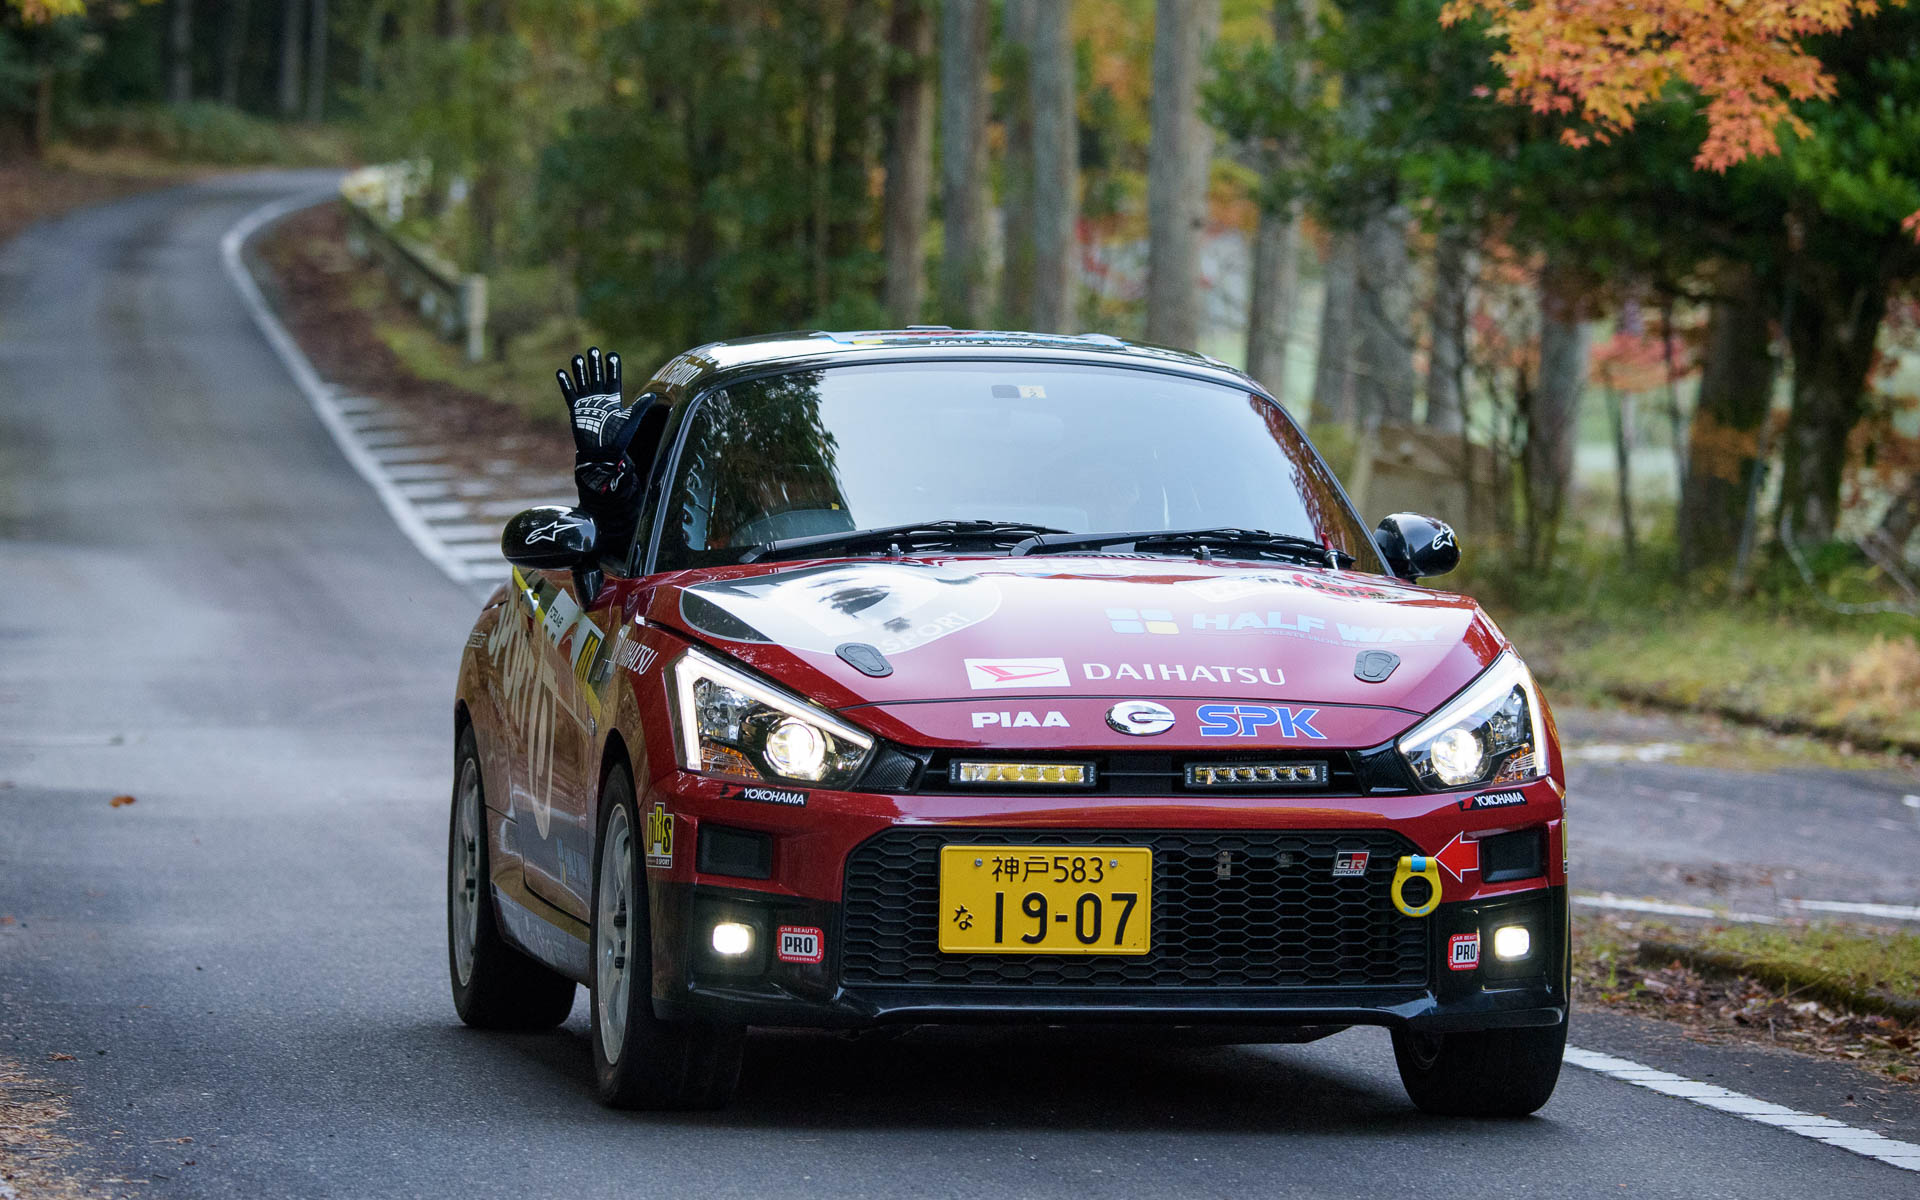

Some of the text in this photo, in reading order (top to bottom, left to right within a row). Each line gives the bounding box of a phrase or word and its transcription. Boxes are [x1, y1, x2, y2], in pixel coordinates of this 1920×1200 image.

[881, 612, 971, 651] SPORT
[1192, 611, 1446, 643] HALF WAY
[1083, 662, 1286, 686] DAIHATSU
[971, 711, 1071, 728] PIAA
[1197, 704, 1328, 740] SPK
[744, 788, 805, 805] YOKOHAMA
[1474, 792, 1525, 807] YOKOHAMA
[1336, 860, 1365, 869] GR
[953, 891, 1138, 946] な 19-07
[793, 927, 819, 935] BEAUTY
[784, 935, 813, 954] PRO
[1456, 943, 1476, 961] PRO
